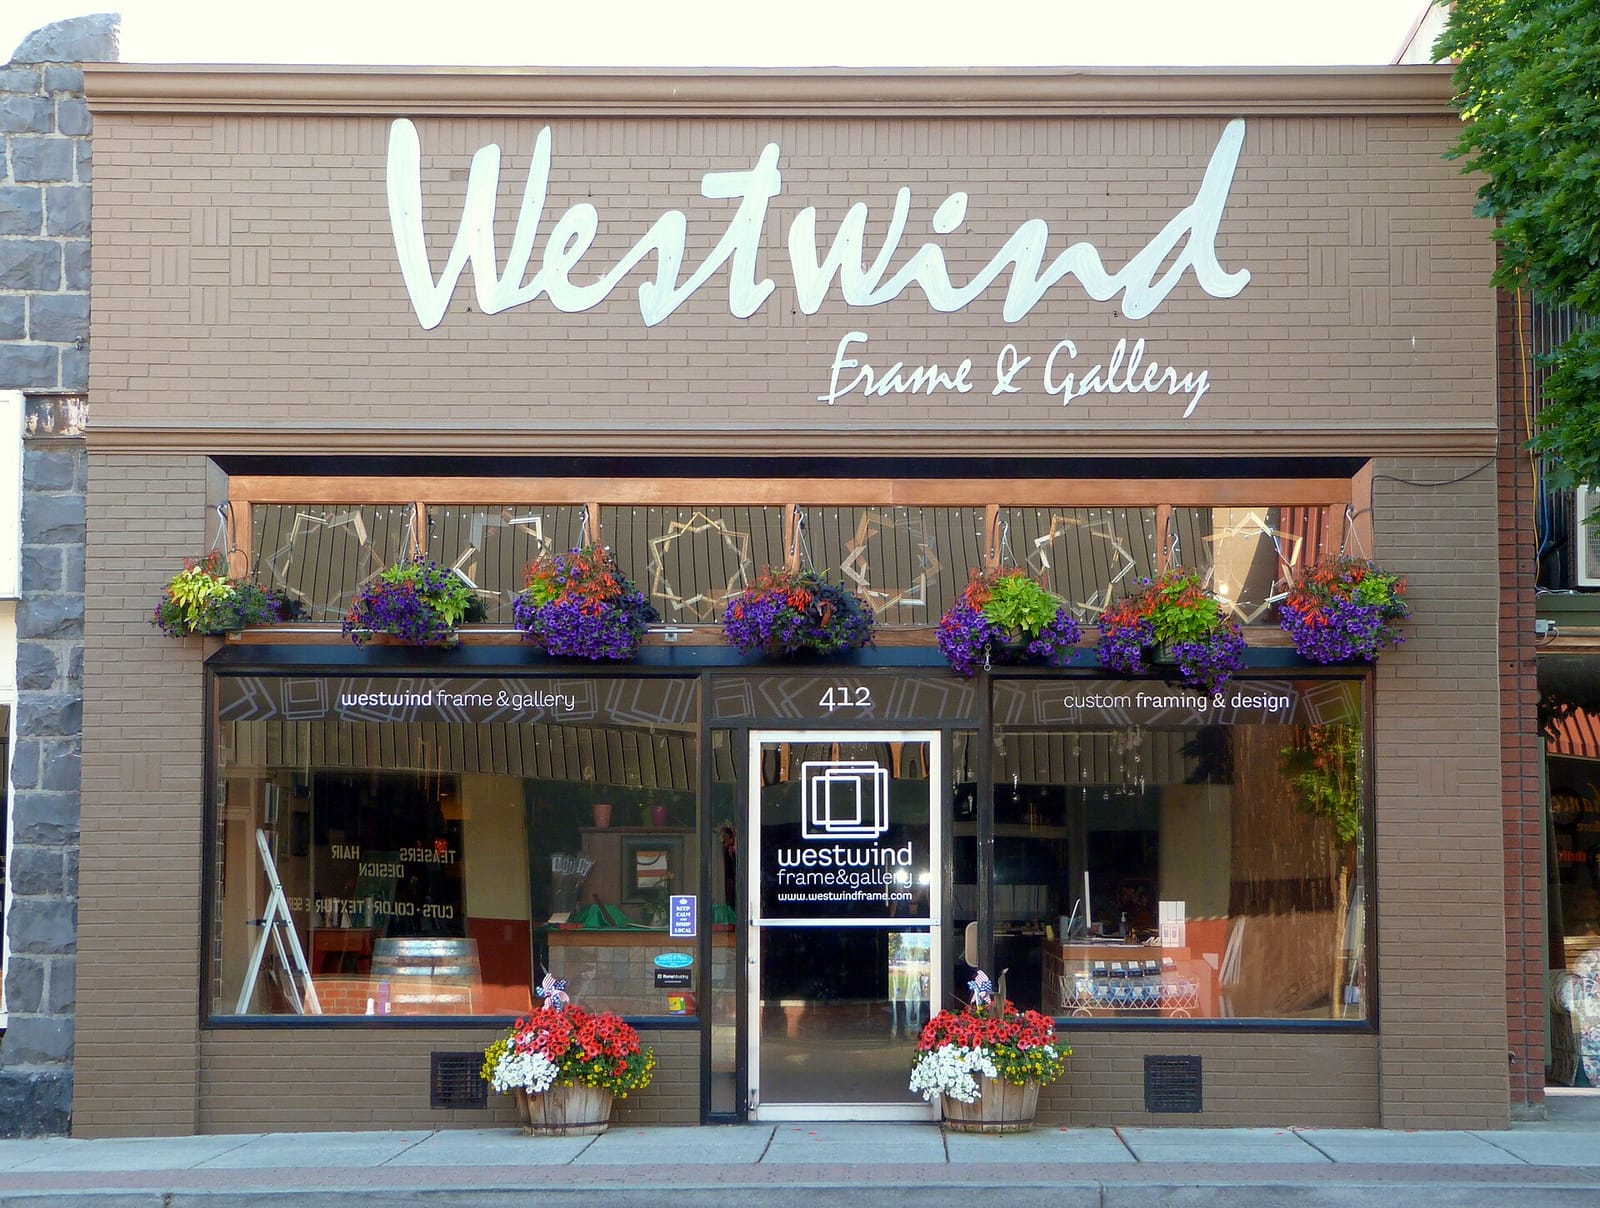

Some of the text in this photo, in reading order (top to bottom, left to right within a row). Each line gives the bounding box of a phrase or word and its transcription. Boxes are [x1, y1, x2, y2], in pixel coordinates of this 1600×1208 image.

[385, 117, 1251, 330] Westwind
[817, 331, 1210, 419] Frame & Gallery
[341, 689, 575, 711] westwind frame & gallery
[818, 686, 872, 712] 412
[1063, 692, 1290, 713] custom framing & design
[777, 841, 913, 867] westwind
[777, 890, 913, 902] www.westwindframe.com
